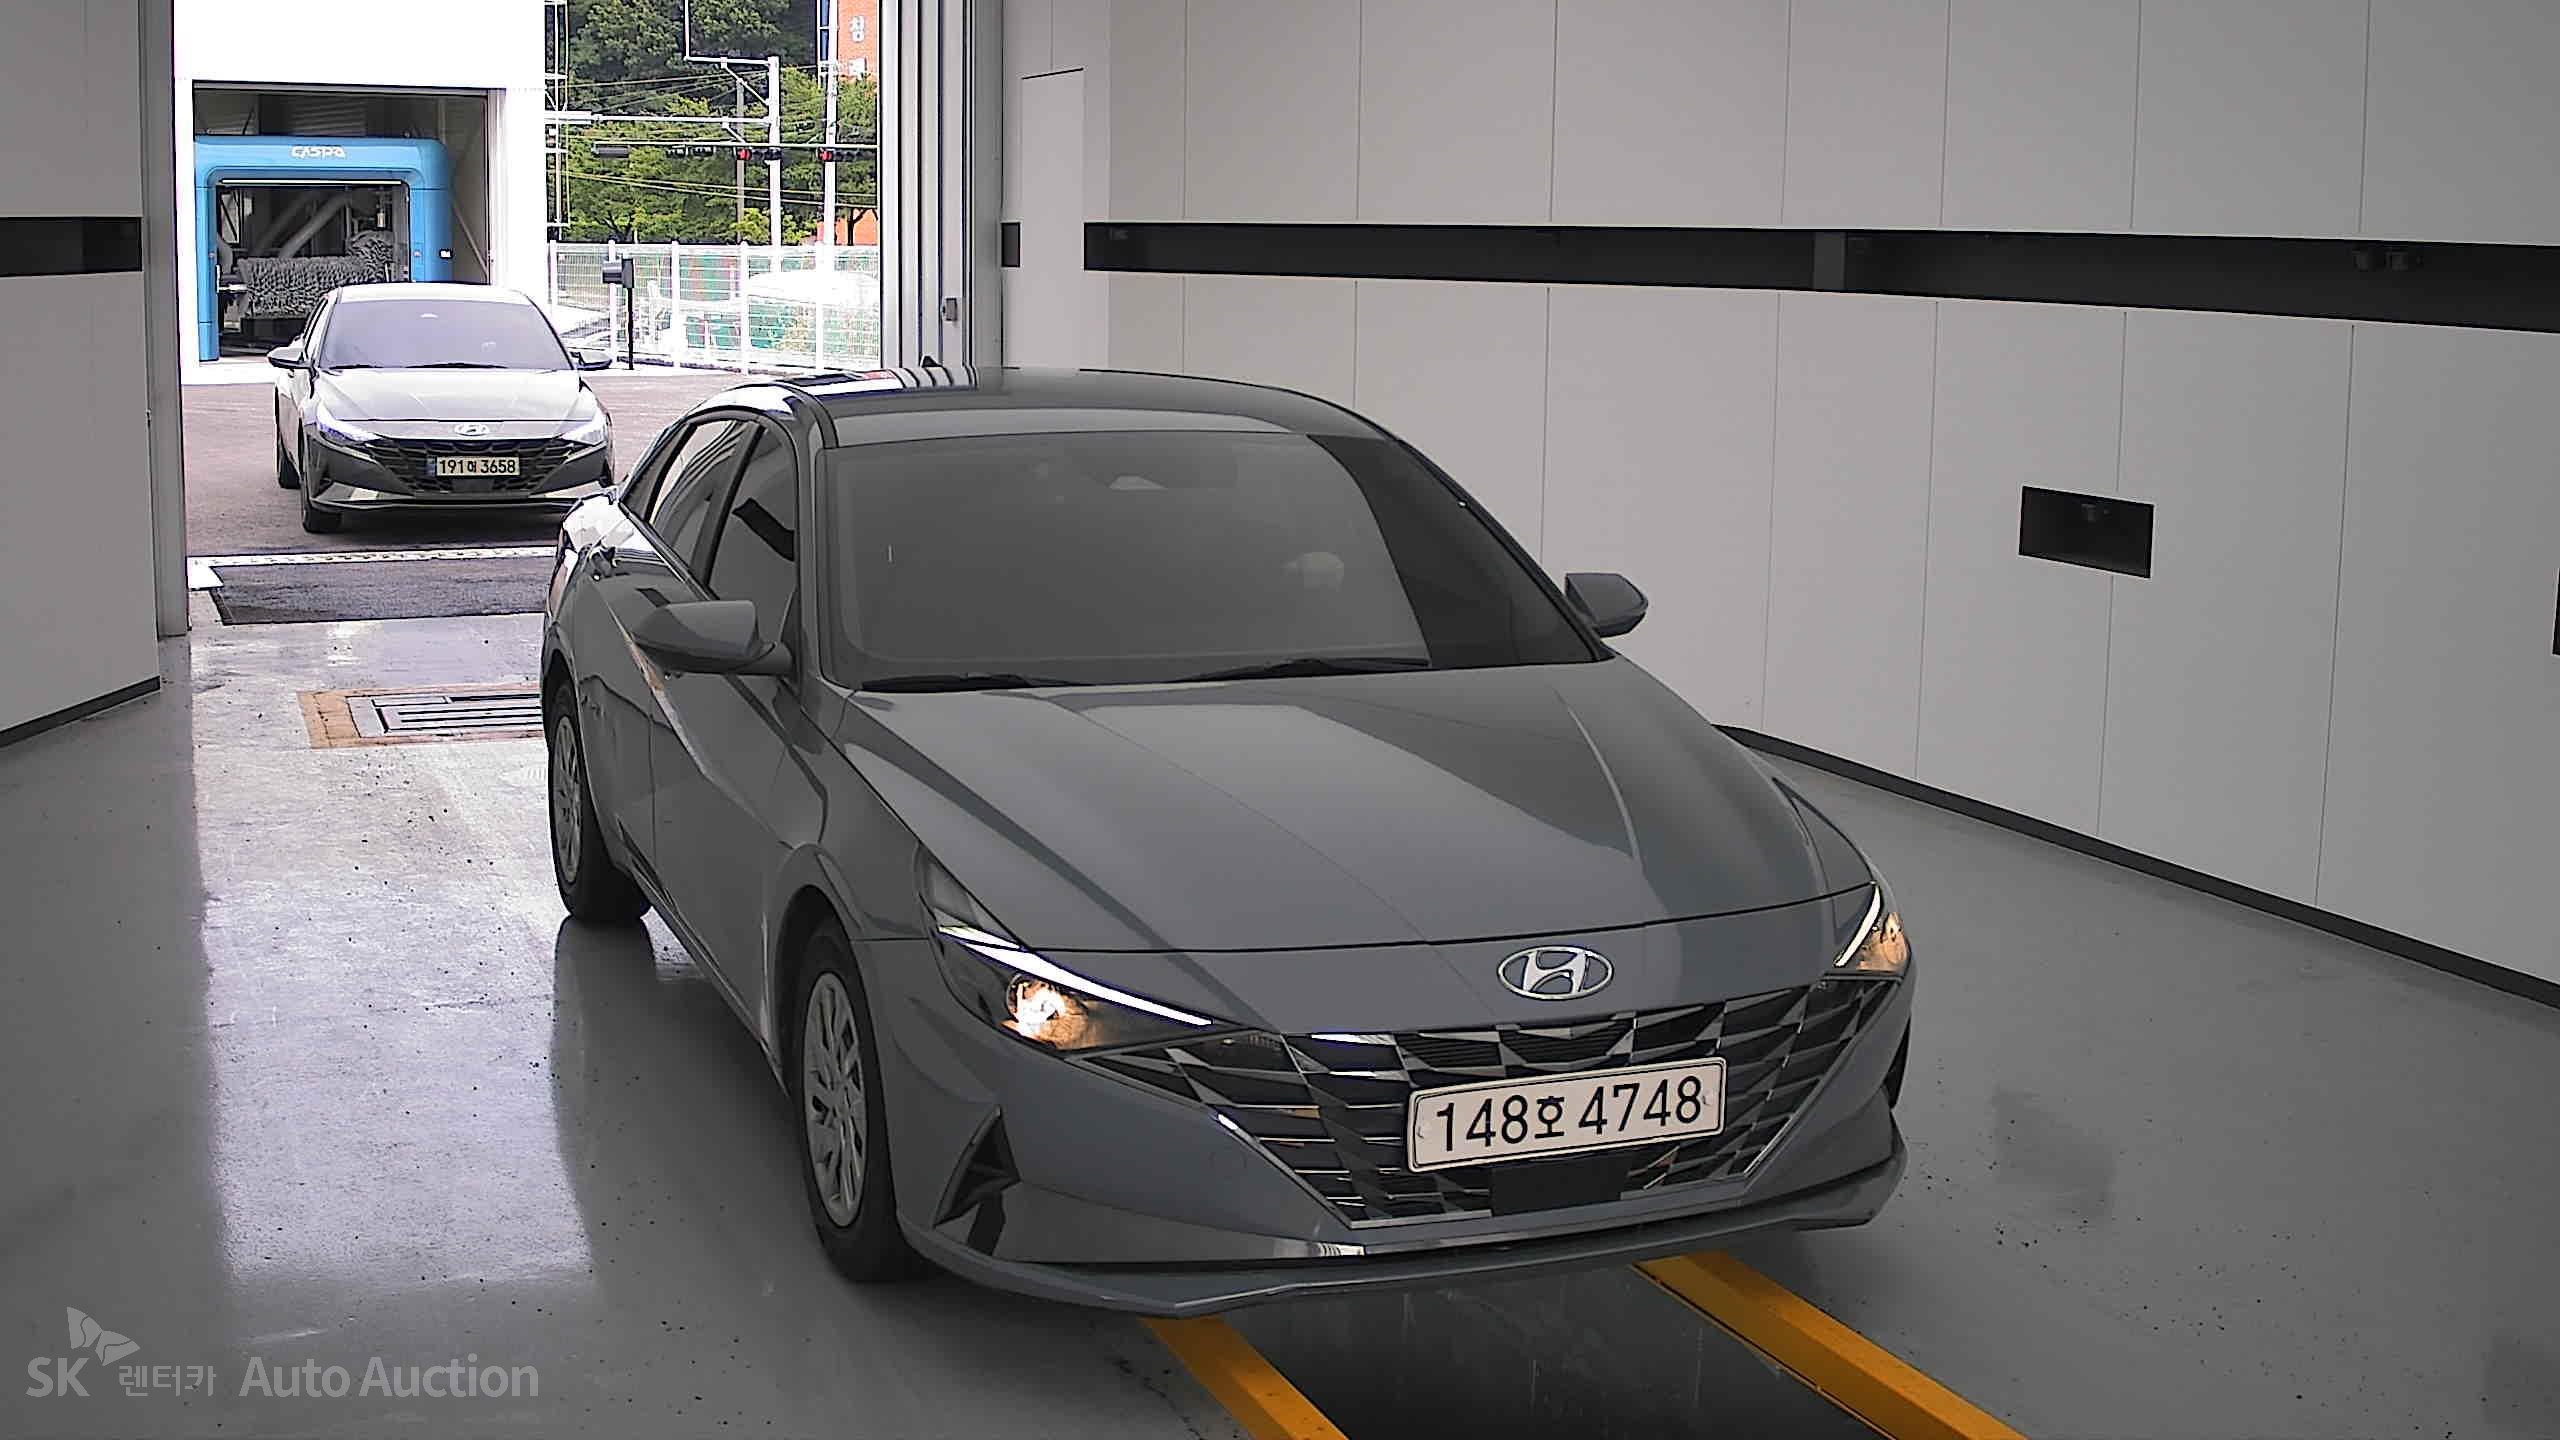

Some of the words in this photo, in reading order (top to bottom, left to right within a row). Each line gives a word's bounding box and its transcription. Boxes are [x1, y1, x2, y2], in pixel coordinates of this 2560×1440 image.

[480, 459, 516, 474] 3658
[1436, 1094, 1565, 1152] 148호
[1578, 1075, 1702, 1135] 4748
